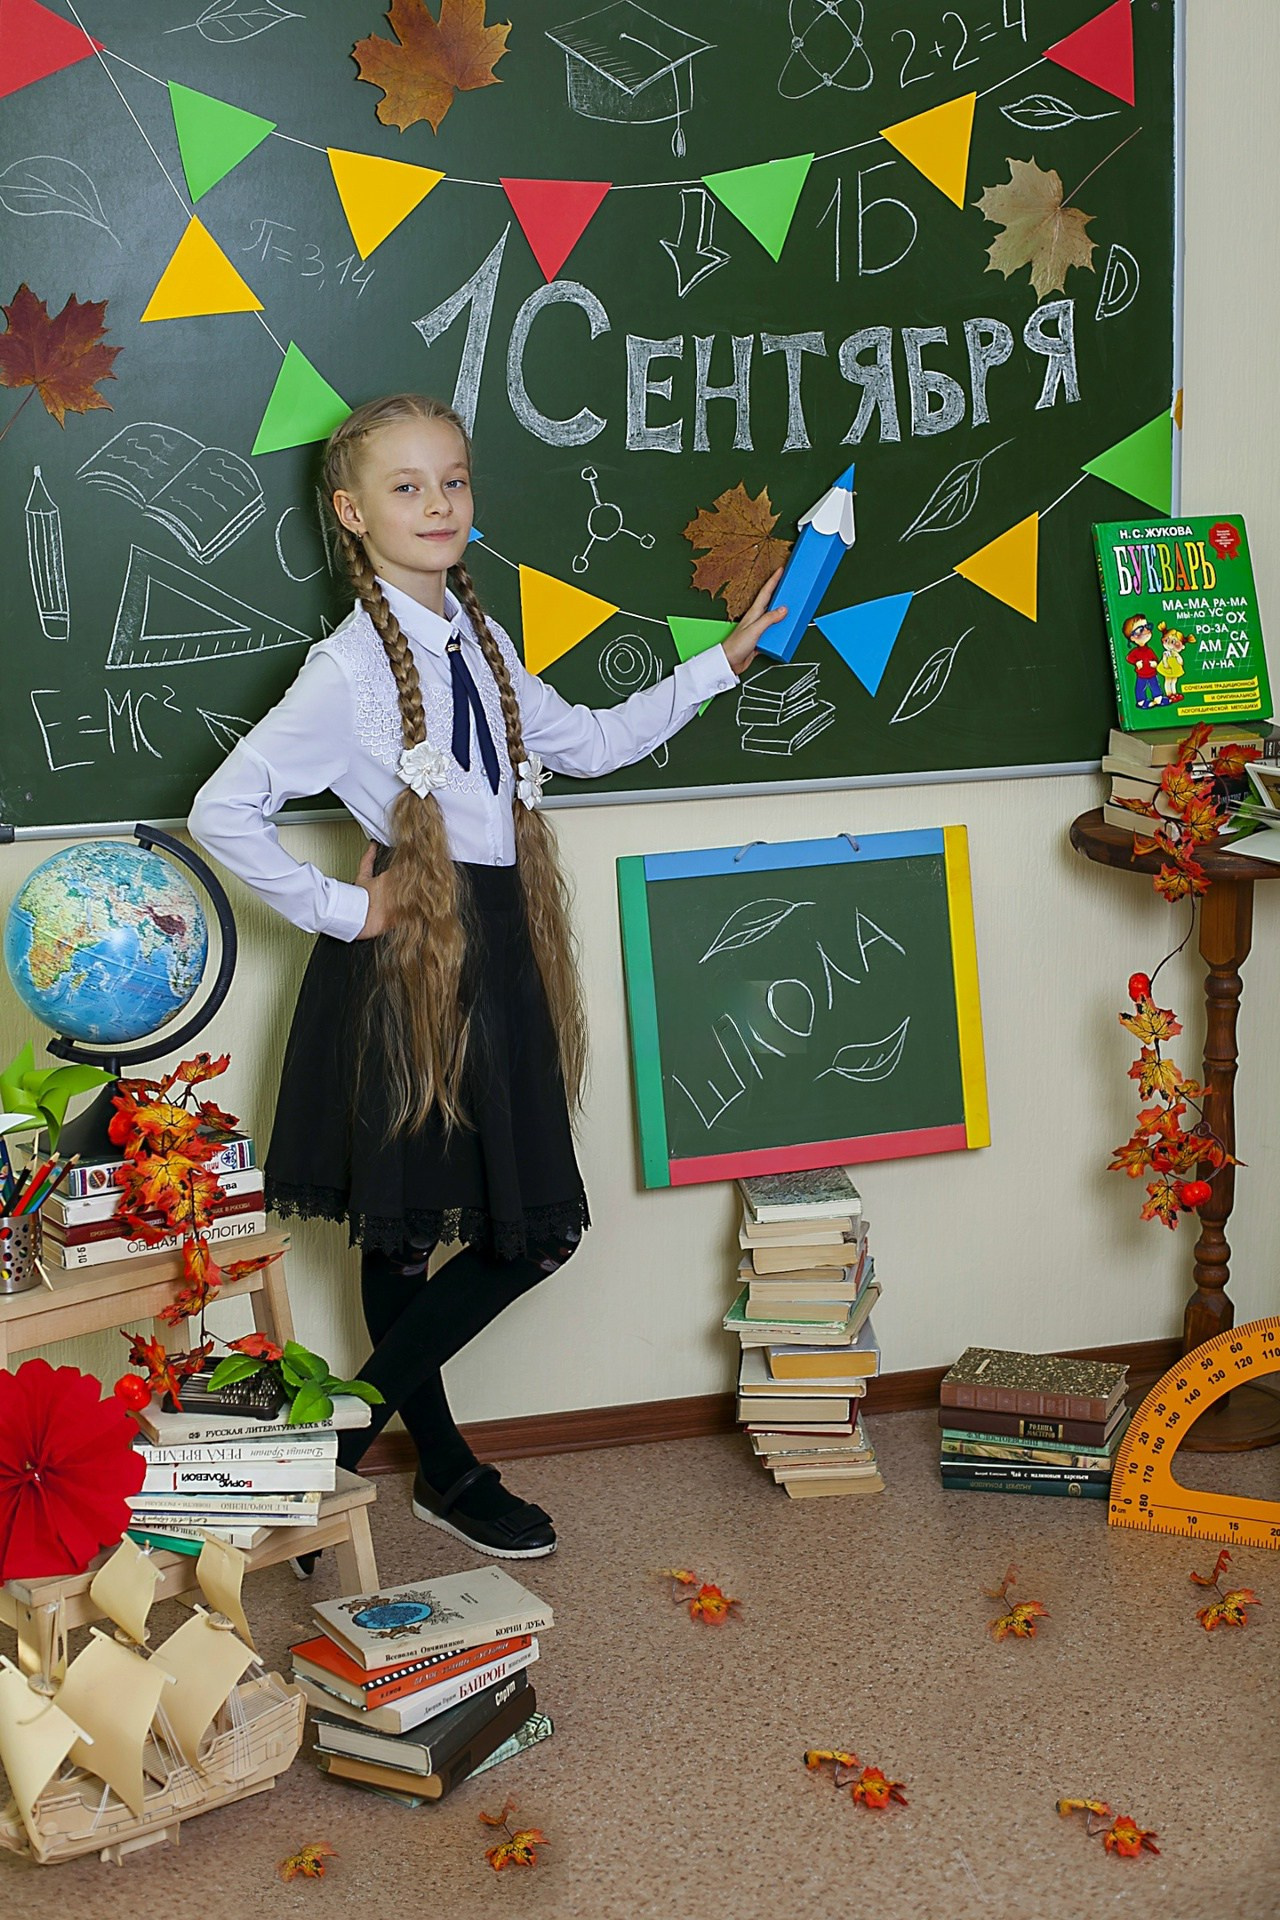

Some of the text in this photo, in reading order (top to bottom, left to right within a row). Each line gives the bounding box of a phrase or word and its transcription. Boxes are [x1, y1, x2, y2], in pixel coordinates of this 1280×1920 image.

[1145, 526, 1193, 538] ЖУКОВА
[1113, 542, 1216, 595] БУКВАРЬ
[1162, 597, 1248, 611] МА-МА РА-МА
[1209, 608, 1224, 617] УС
[1226, 611, 1247, 623] ОХ
[1195, 623, 1248, 641] РО-ЗА СА
[1199, 639, 1250, 659] АМ АУ
[1202, 659, 1235, 670] ЛУ-НА
[1261, 1332, 1275, 1342] 70
[1230, 1342, 1244, 1354] 60
[1200, 1358, 1214, 1371] 50
[1234, 1356, 1253, 1370] 120
[1207, 1370, 1226, 1385] 130
[1175, 1378, 1188, 1392] 40
[1184, 1388, 1201, 1405] 140
[1154, 1403, 1167, 1417] 30
[1165, 1411, 1181, 1429] 150
[205, 1428, 243, 1438] РУССКАЯ
[244, 1423, 297, 1434] ЛИТЕРАТУРА
[1138, 1432, 1150, 1446] 20
[1151, 1437, 1165, 1455] 160
[210, 1448, 242, 1461] РЕКА
[1128, 1462, 1139, 1475] 10
[1142, 1465, 1155, 1484] 170
[181, 1472, 230, 1482] ПОЛЕВОЙ
[219, 1479, 252, 1488] БОРИС
[220, 1502, 273, 1512] КОРОЛЕНКО
[1111, 1504, 1117, 1512] 0
[1139, 1494, 1149, 1512] 180
[1148, 1510, 1154, 1518] 5
[1187, 1515, 1197, 1524] 10
[1229, 1522, 1239, 1531] 15
[1270, 1528, 1280, 1537] 20
[495, 1619, 546, 1637] КОРНИ ДУБА
[459, 1663, 506, 1699] БАЙРОН
